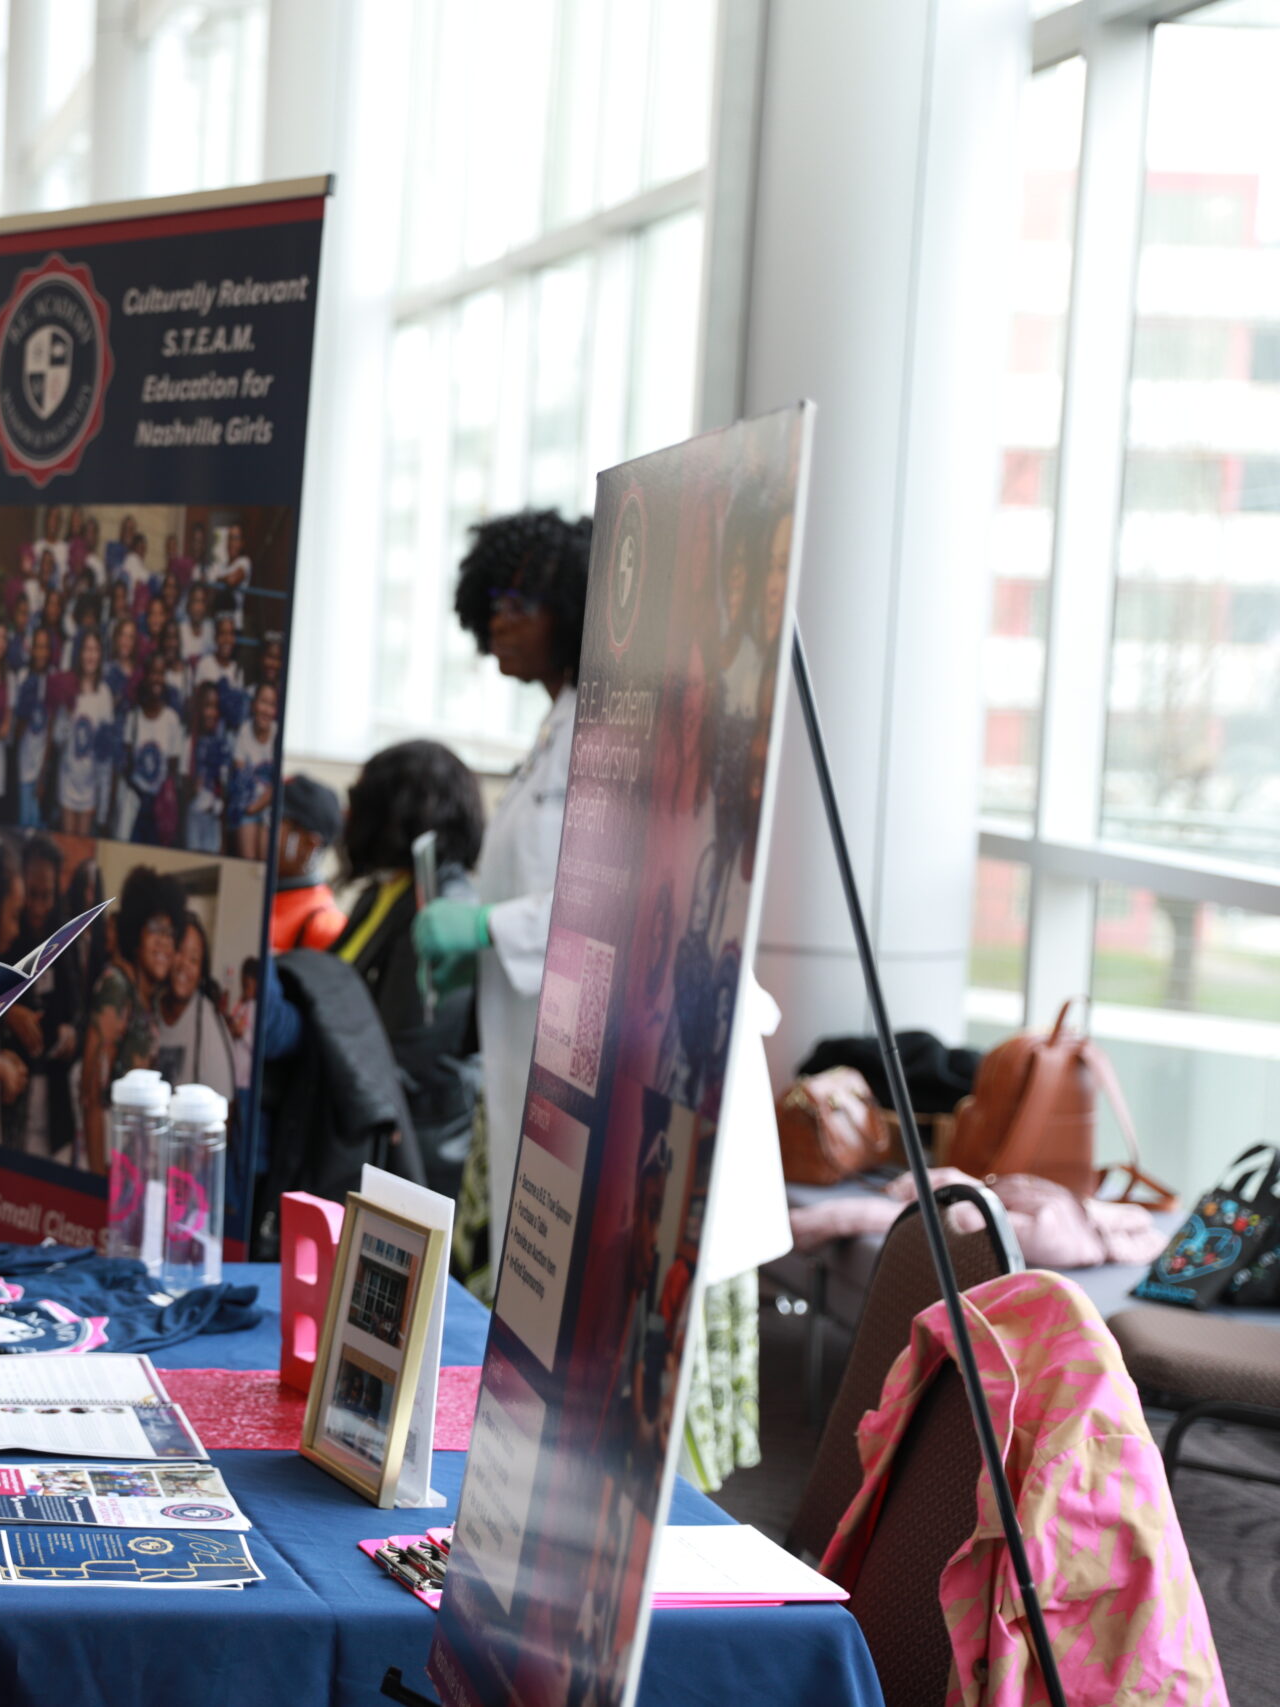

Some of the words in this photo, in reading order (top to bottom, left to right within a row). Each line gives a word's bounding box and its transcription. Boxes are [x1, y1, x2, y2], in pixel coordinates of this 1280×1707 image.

[123, 281, 215, 316] Culturally
[218, 276, 310, 308] Relevant
[162, 325, 255, 357] S.T.E.A.M.
[141, 374, 237, 404] Education
[240, 368, 273, 399] for
[135, 418, 222, 447] Nashville
[224, 416, 273, 446] Girls
[602, 680, 658, 740] Academy
[572, 733, 640, 794] Scholarship
[44, 1210, 94, 1249] Class
